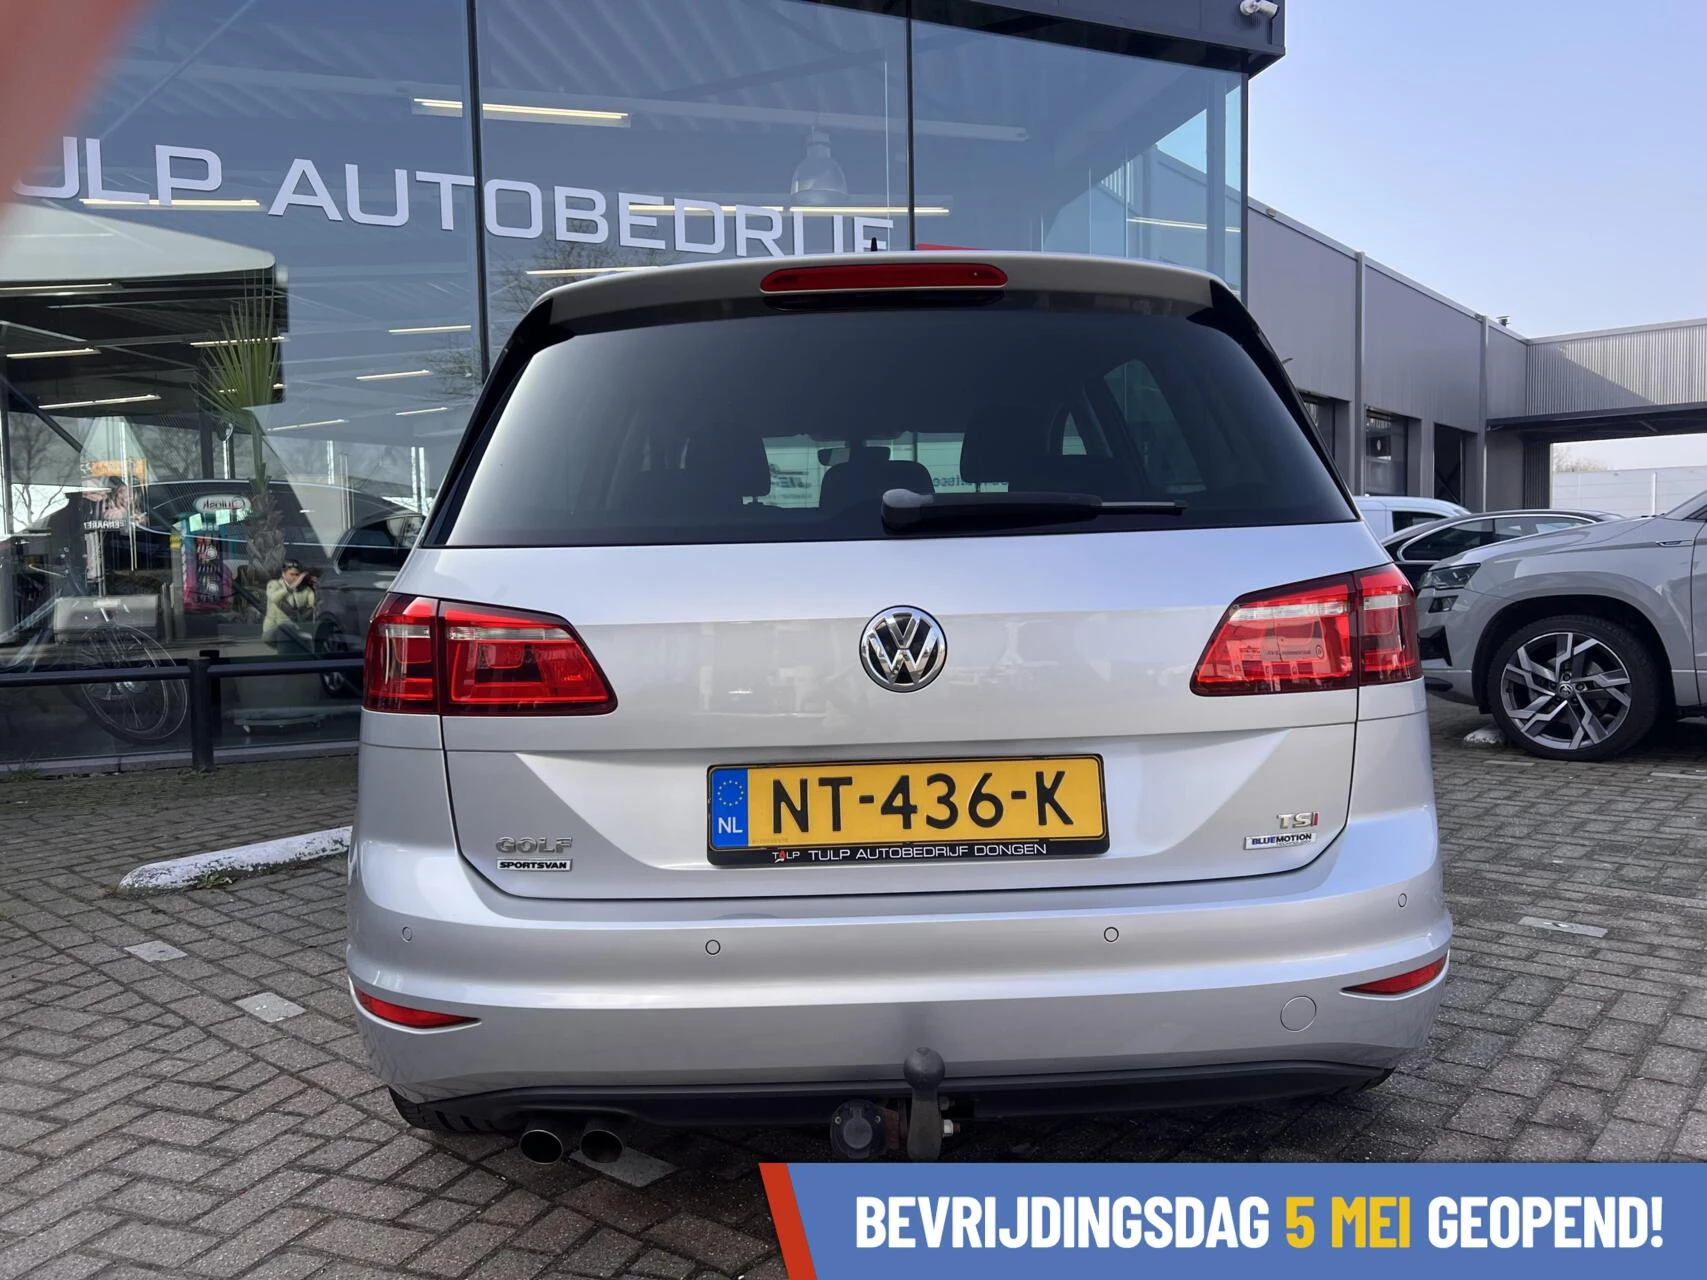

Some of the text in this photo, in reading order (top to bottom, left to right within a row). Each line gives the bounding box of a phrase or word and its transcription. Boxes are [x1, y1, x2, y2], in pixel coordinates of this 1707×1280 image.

[11, 135, 222, 207] ULP
[718, 770, 1074, 834] NL NT-436-K
[1276, 811, 1319, 829] TSI
[495, 836, 572, 854] GOLF
[1251, 833, 1312, 845] BLUEMOTION
[808, 849, 851, 861] TULP
[855, 845, 969, 860] AUTOBEDRIJF
[974, 843, 1047, 857] DONGEN
[499, 861, 567, 869] SPORTSVAN
